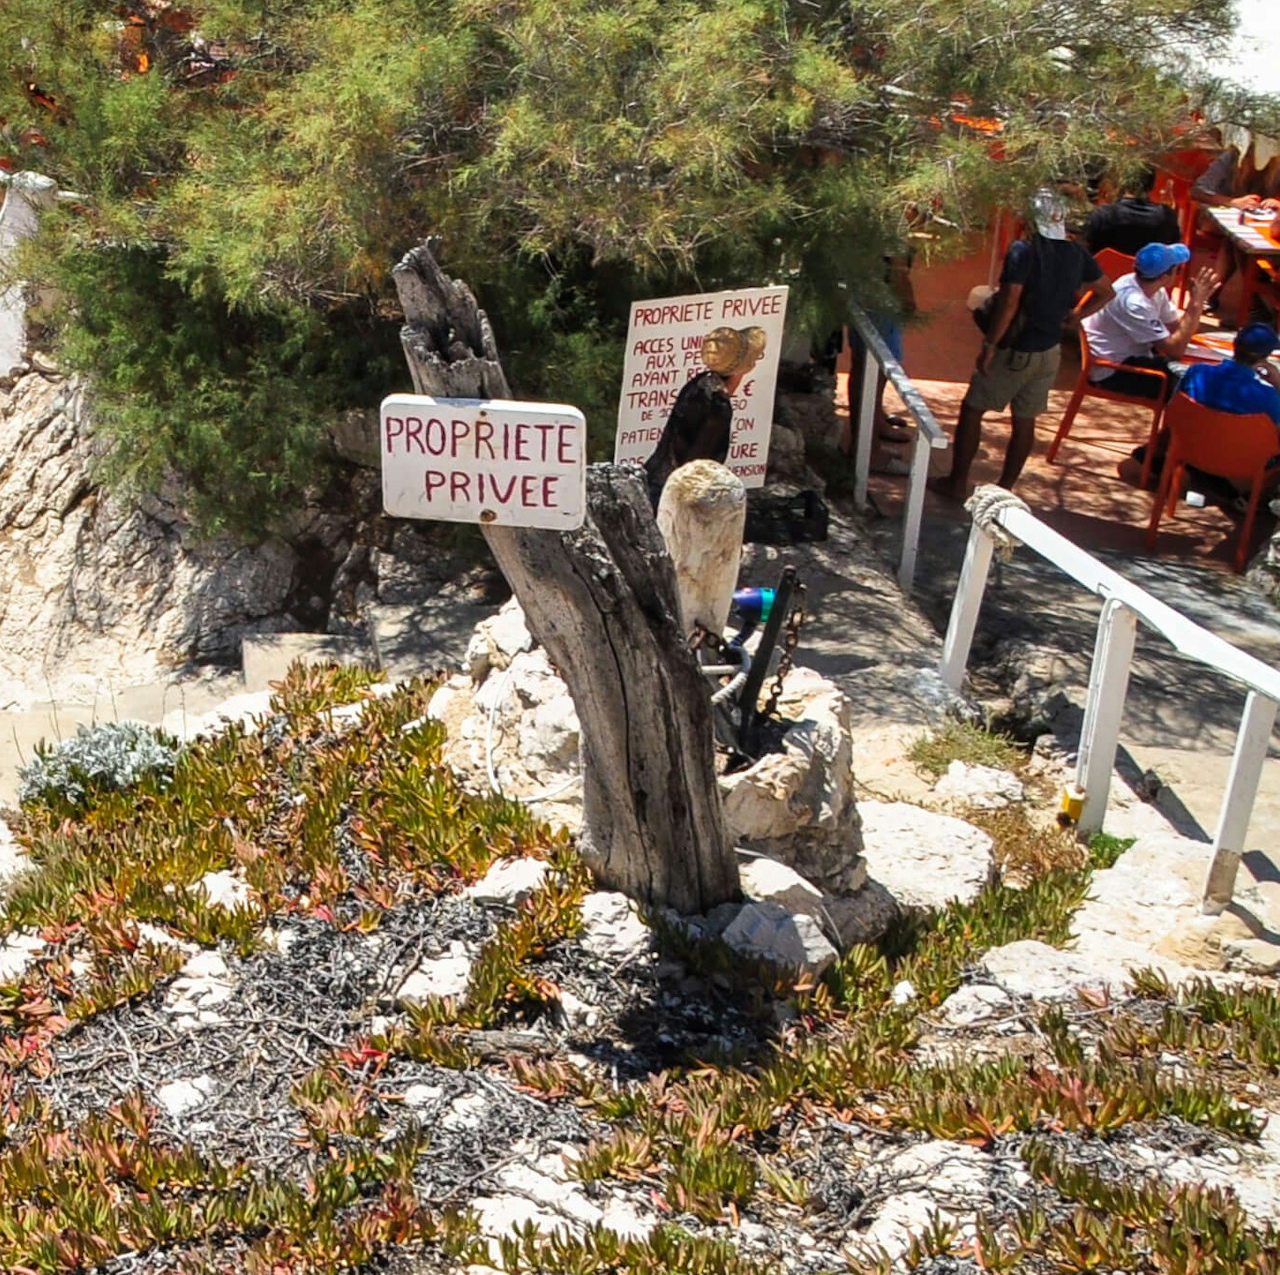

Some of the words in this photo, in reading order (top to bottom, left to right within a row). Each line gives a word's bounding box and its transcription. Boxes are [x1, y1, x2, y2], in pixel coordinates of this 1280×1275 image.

[634, 301, 714, 326] PROPRIETE
[722, 295, 782, 319] PRIVEE
[633, 336, 674, 355] ACCES
[645, 354, 677, 370] AUX
[632, 370, 680, 388] AYANT
[743, 379, 755, 396] €
[641, 410, 653, 422] DE
[386, 417, 577, 464] PROPRIETE
[425, 470, 559, 508] PRIVEE
